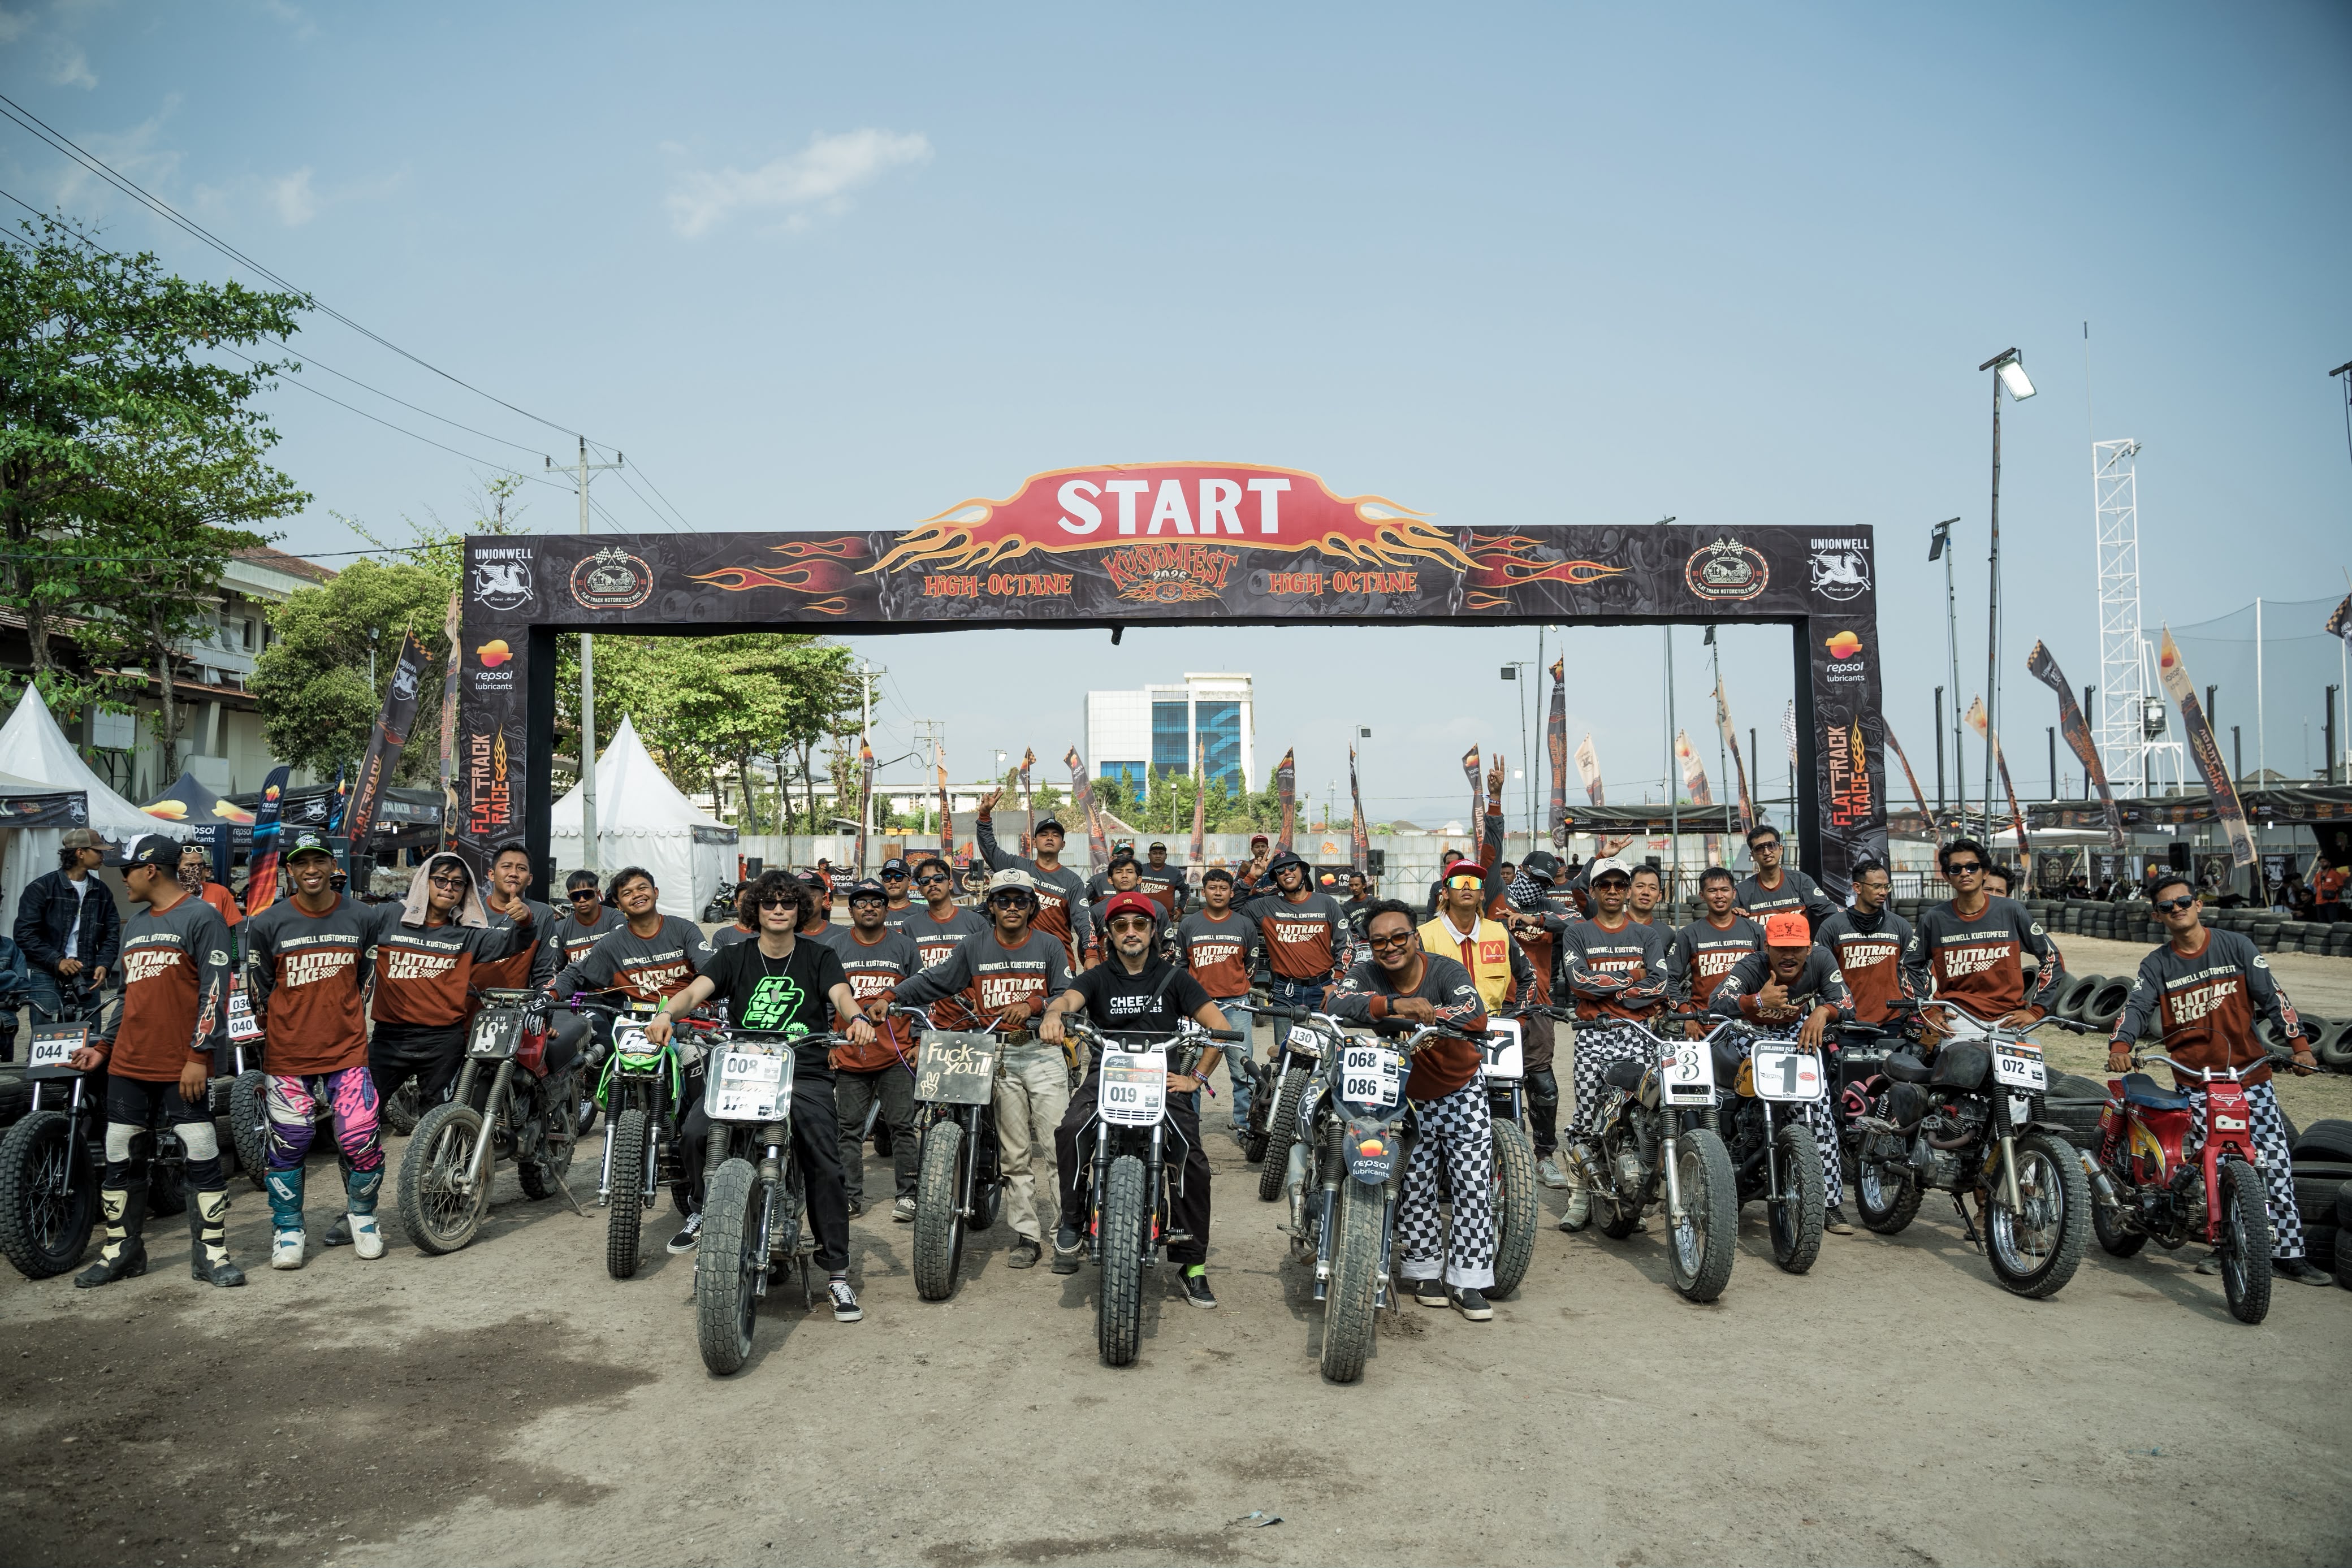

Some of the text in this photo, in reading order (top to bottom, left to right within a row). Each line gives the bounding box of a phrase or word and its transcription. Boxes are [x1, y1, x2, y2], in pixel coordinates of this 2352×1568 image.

[1057, 478, 1291, 535] START
[1811, 539, 1869, 549] UNIONWELL
[475, 548, 533, 560] UNIONWELL
[1100, 543, 1239, 591] KUSTOMFEST
[1153, 570, 1187, 583] 2026
[1697, 583, 1706, 591] FLAT
[1748, 583, 1758, 592] RACE
[581, 591, 589, 601] FLAT
[632, 591, 642, 600] RACE
[1826, 662, 1864, 673] repsol
[475, 670, 513, 681] repsol
[1851, 772, 1872, 816] RACE
[491, 780, 510, 824] RACE
[194, 826, 215, 835] psol
[831, 874, 854, 883] epsol
[1338, 873, 1350, 882] rep
[1040, 881, 1067, 894] KUSTOMFEST
[281, 934, 359, 948] UNIONWELL KUSTOMFEST
[567, 935, 590, 946] UNIONWELL
[916, 934, 942, 943] UNIONWELL
[1278, 933, 1298, 943] RACE
[1971, 931, 2009, 940] KUSTOMFEST
[391, 934, 464, 951] UNIONWELL KUSTOMFEST
[866, 960, 900, 969] KUSTOMFEST
[978, 961, 1010, 972] UNIONWELL
[1195, 954, 1214, 969] RACE
[1844, 956, 1867, 969] RACE
[388, 964, 418, 979] RACE
[1700, 963, 1724, 977] RACE
[1947, 961, 1971, 978] RACE
[287, 967, 319, 987] RACE
[2166, 974, 2199, 989] NIONWELL
[983, 991, 1012, 1010] RACE
[2175, 1002, 2207, 1025] RACE
[232, 1020, 253, 1033] 040
[1293, 1030, 1312, 1043] 130
[36, 1044, 63, 1059] 044
[727, 1058, 759, 1074] 008
[1348, 1052, 1377, 1068] 068
[1675, 1050, 1700, 1081] 3
[2003, 1059, 2025, 1075] 072
[1775, 1056, 1798, 1093] 1
[1347, 1078, 1377, 1095] 086
[1110, 1086, 1137, 1103] 019
[1353, 1160, 1390, 1169] repsol
[1352, 1168, 1390, 1178] lubricants
